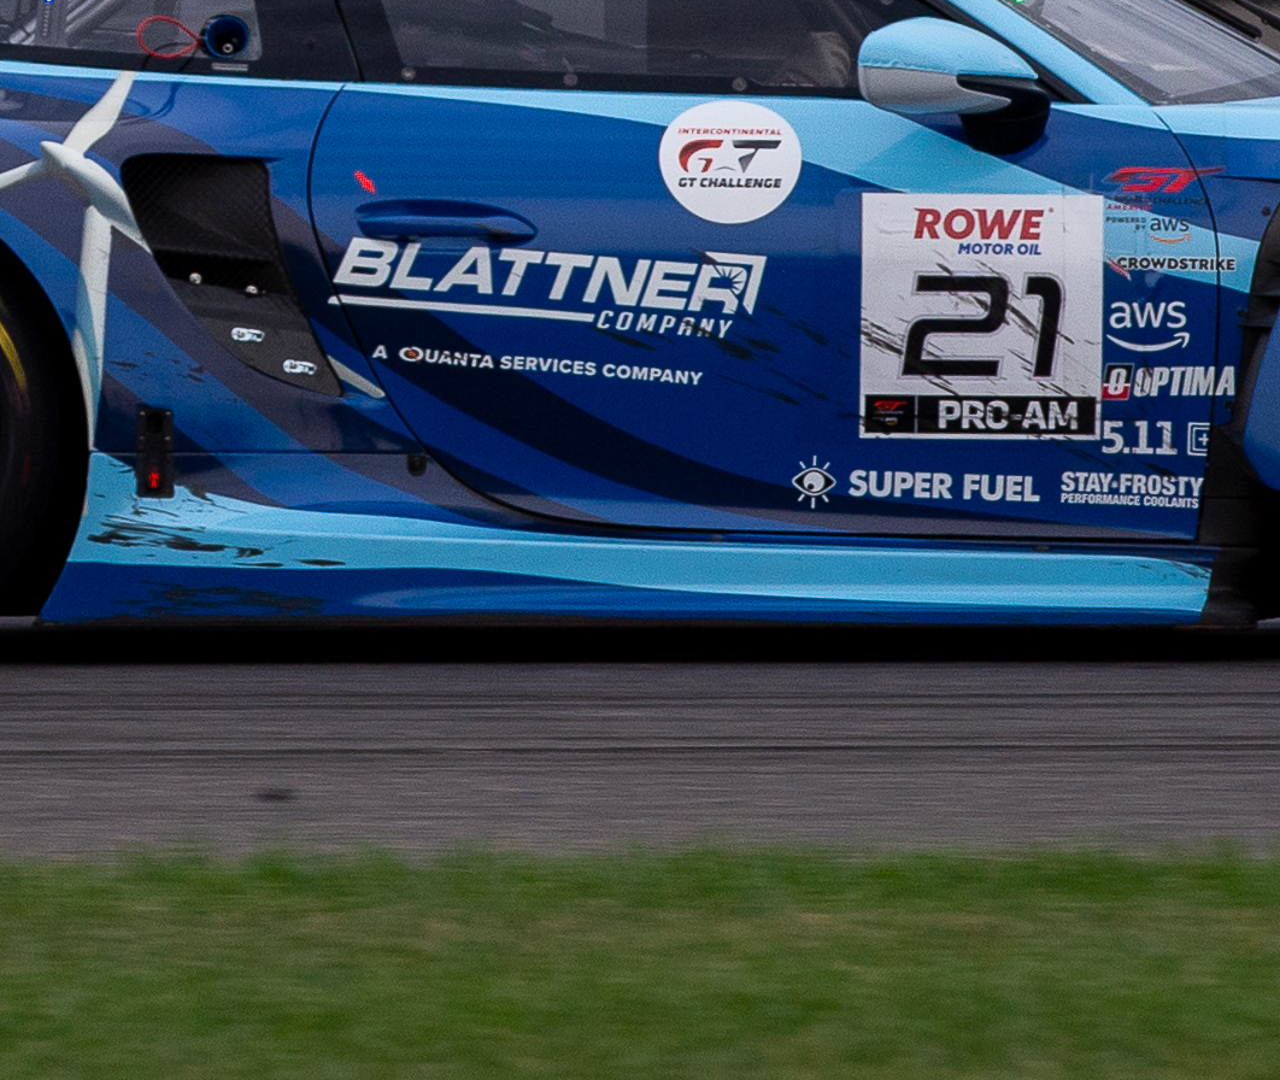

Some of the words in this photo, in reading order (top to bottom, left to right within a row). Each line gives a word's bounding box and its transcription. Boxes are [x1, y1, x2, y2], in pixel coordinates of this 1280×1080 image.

[677, 128, 782, 136] INTERCONTINENTAL
[678, 177, 697, 188] GT
[699, 177, 782, 189] CHALLENGE
[913, 208, 1045, 240] ROWE
[1149, 217, 1190, 232] aws
[957, 243, 1013, 256] MOTOR
[1017, 244, 1042, 256] OIL
[1116, 257, 1236, 271] CROWDSTRIKE
[333, 236, 746, 315] BLATTNER
[596, 309, 734, 339] COMPANY
[901, 275, 1063, 378] 21
[1109, 301, 1187, 329] aws
[372, 345, 388, 359] A
[398, 345, 494, 369] QUANTA
[499, 355, 597, 376] SERVICES
[602, 363, 704, 386] COMPANY
[1133, 365, 1237, 397] OPTIMA
[938, 400, 1079, 430] PRO-AM
[1101, 421, 1178, 456] 5.11
[848, 470, 952, 499] SUPER
[963, 473, 1040, 502] FUEL
[1060, 492, 1140, 506] PERFORMANCE
[1143, 496, 1199, 509] COOLANTS
